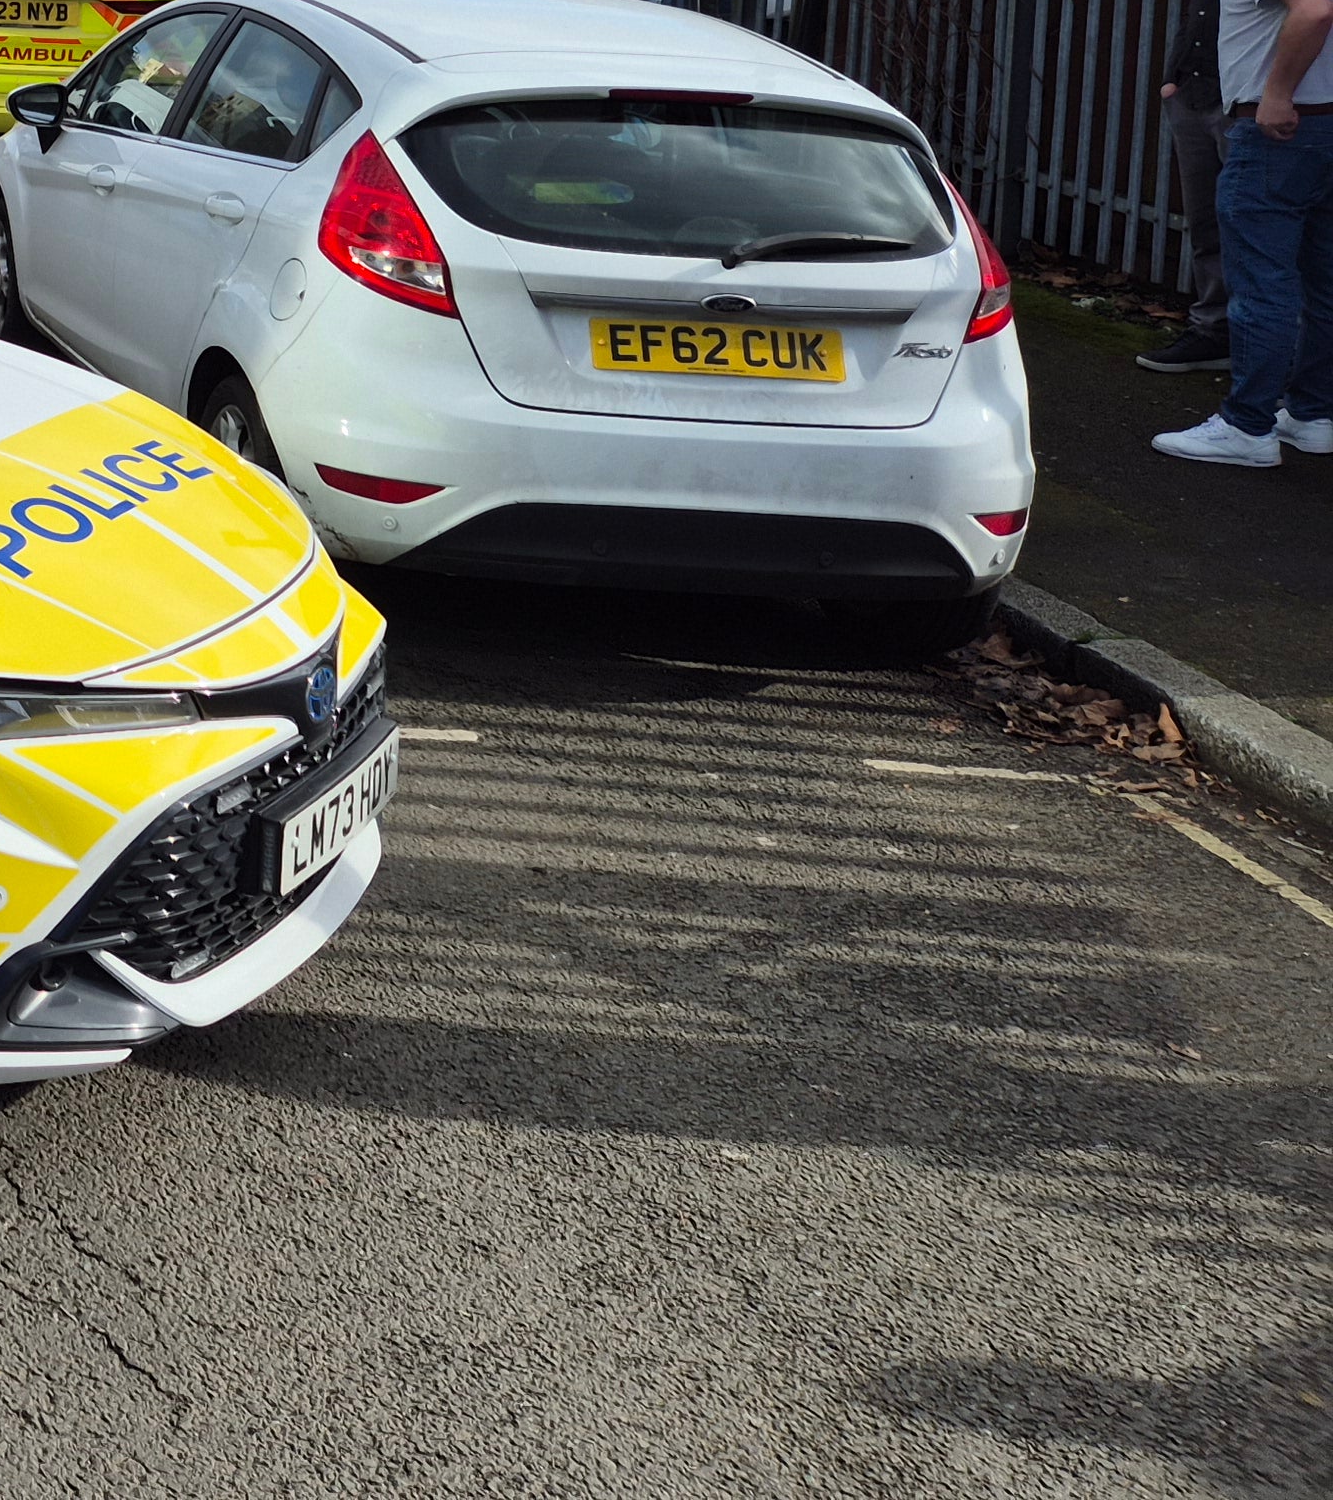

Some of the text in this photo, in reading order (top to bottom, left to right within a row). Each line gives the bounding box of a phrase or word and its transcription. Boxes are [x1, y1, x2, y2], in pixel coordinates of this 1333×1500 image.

[27, 1, 69, 22] NYB
[608, 323, 828, 372] EF62 CUK
[293, 783, 355, 877] LM73
